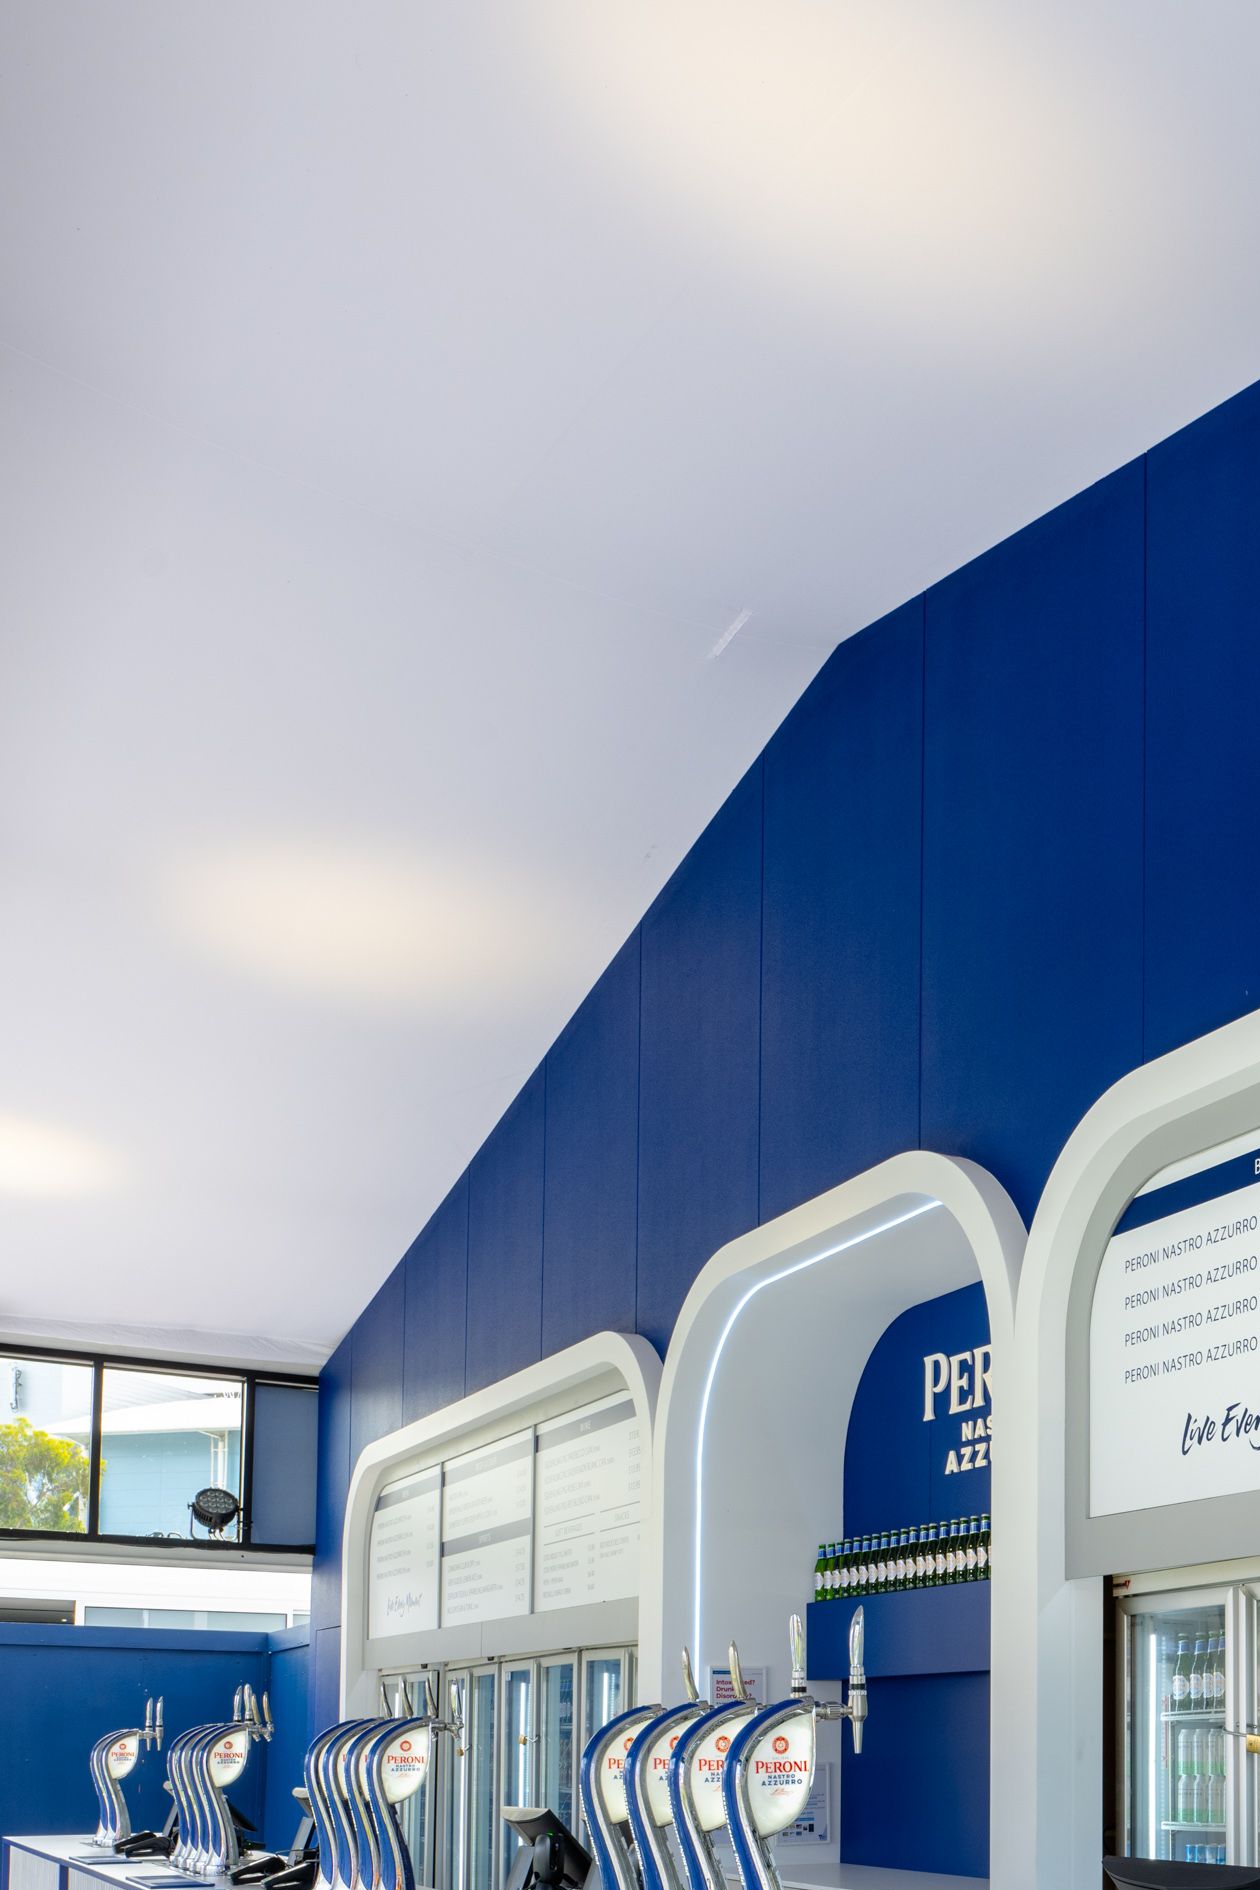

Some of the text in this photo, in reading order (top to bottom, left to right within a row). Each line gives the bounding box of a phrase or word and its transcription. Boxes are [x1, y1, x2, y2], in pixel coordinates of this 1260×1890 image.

[1124, 1249, 1160, 1274] PERONI
[1162, 1234, 1203, 1261] NASTRO
[1205, 1215, 1258, 1246] AZZURRO
[1124, 1287, 1160, 1311] PERONI
[1162, 1273, 1203, 1299] NASTRO
[1205, 1255, 1258, 1285] AZZURRO
[1124, 1324, 1160, 1347] PERONI
[1162, 1312, 1203, 1337] NASTRO
[1205, 1295, 1258, 1324] AZZURRO
[1124, 1361, 1160, 1384] PERONI
[1162, 1350, 1204, 1374] NASTRO
[1205, 1335, 1258, 1363] AZZURRO
[1181, 1412, 1216, 1456] Live
[945, 1441, 992, 1474] AZZ
[386, 1755, 425, 1764] PERONI
[756, 1760, 809, 1774] PERONI
[761, 1779, 803, 1787] AZZURRO
